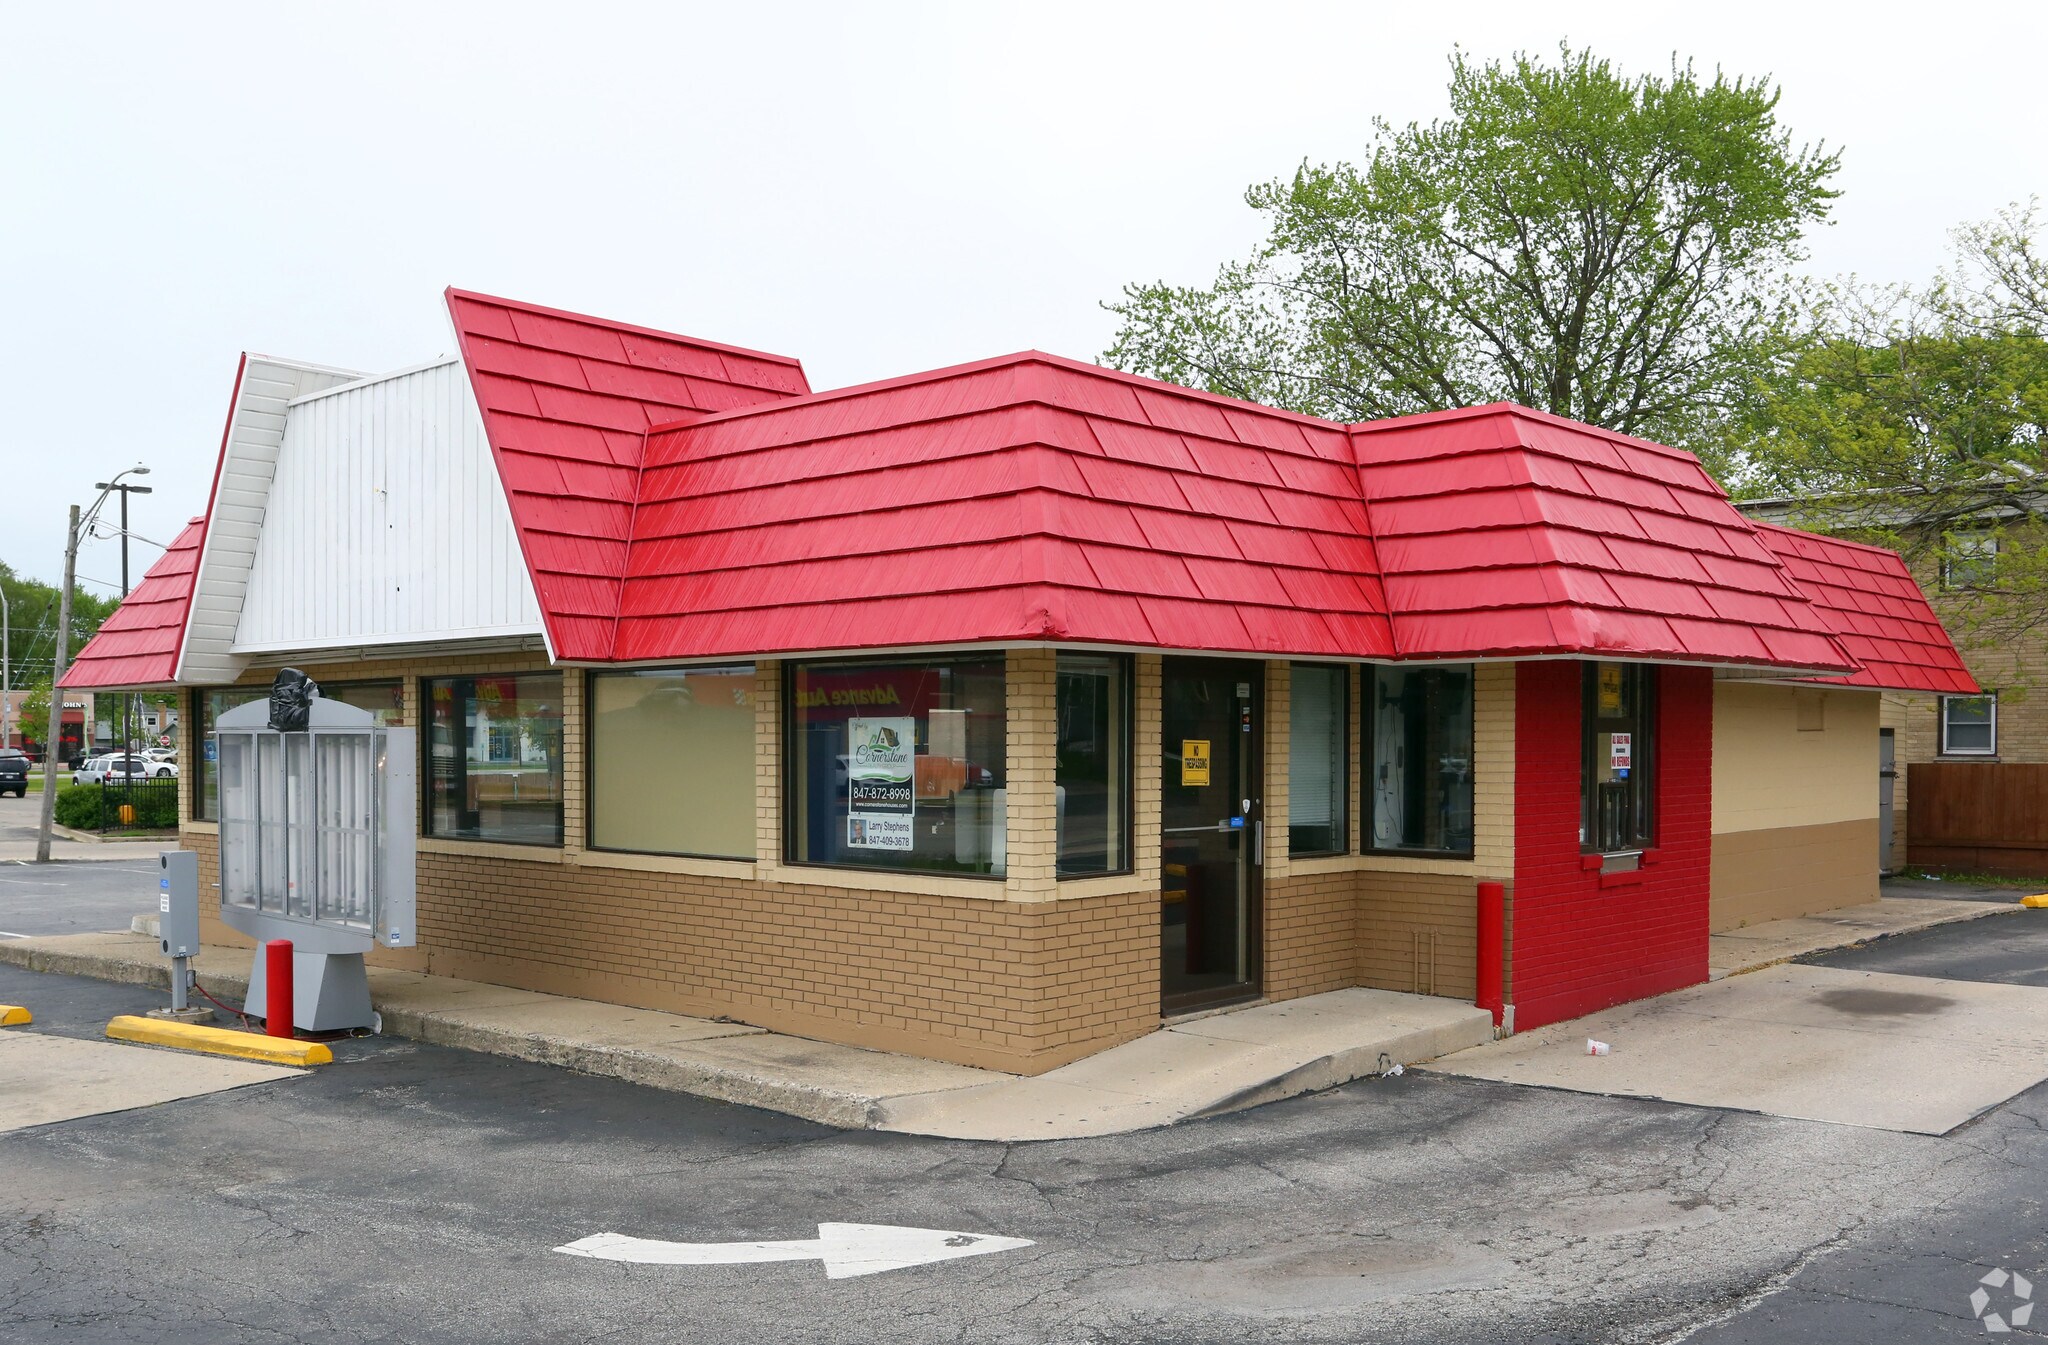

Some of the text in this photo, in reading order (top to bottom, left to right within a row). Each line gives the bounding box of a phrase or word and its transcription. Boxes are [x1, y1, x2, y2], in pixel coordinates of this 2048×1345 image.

[855, 744, 909, 765] Cornerstone
[853, 787, 911, 801] 847-872-8998
[868, 821, 910, 834] Larry Stephens
